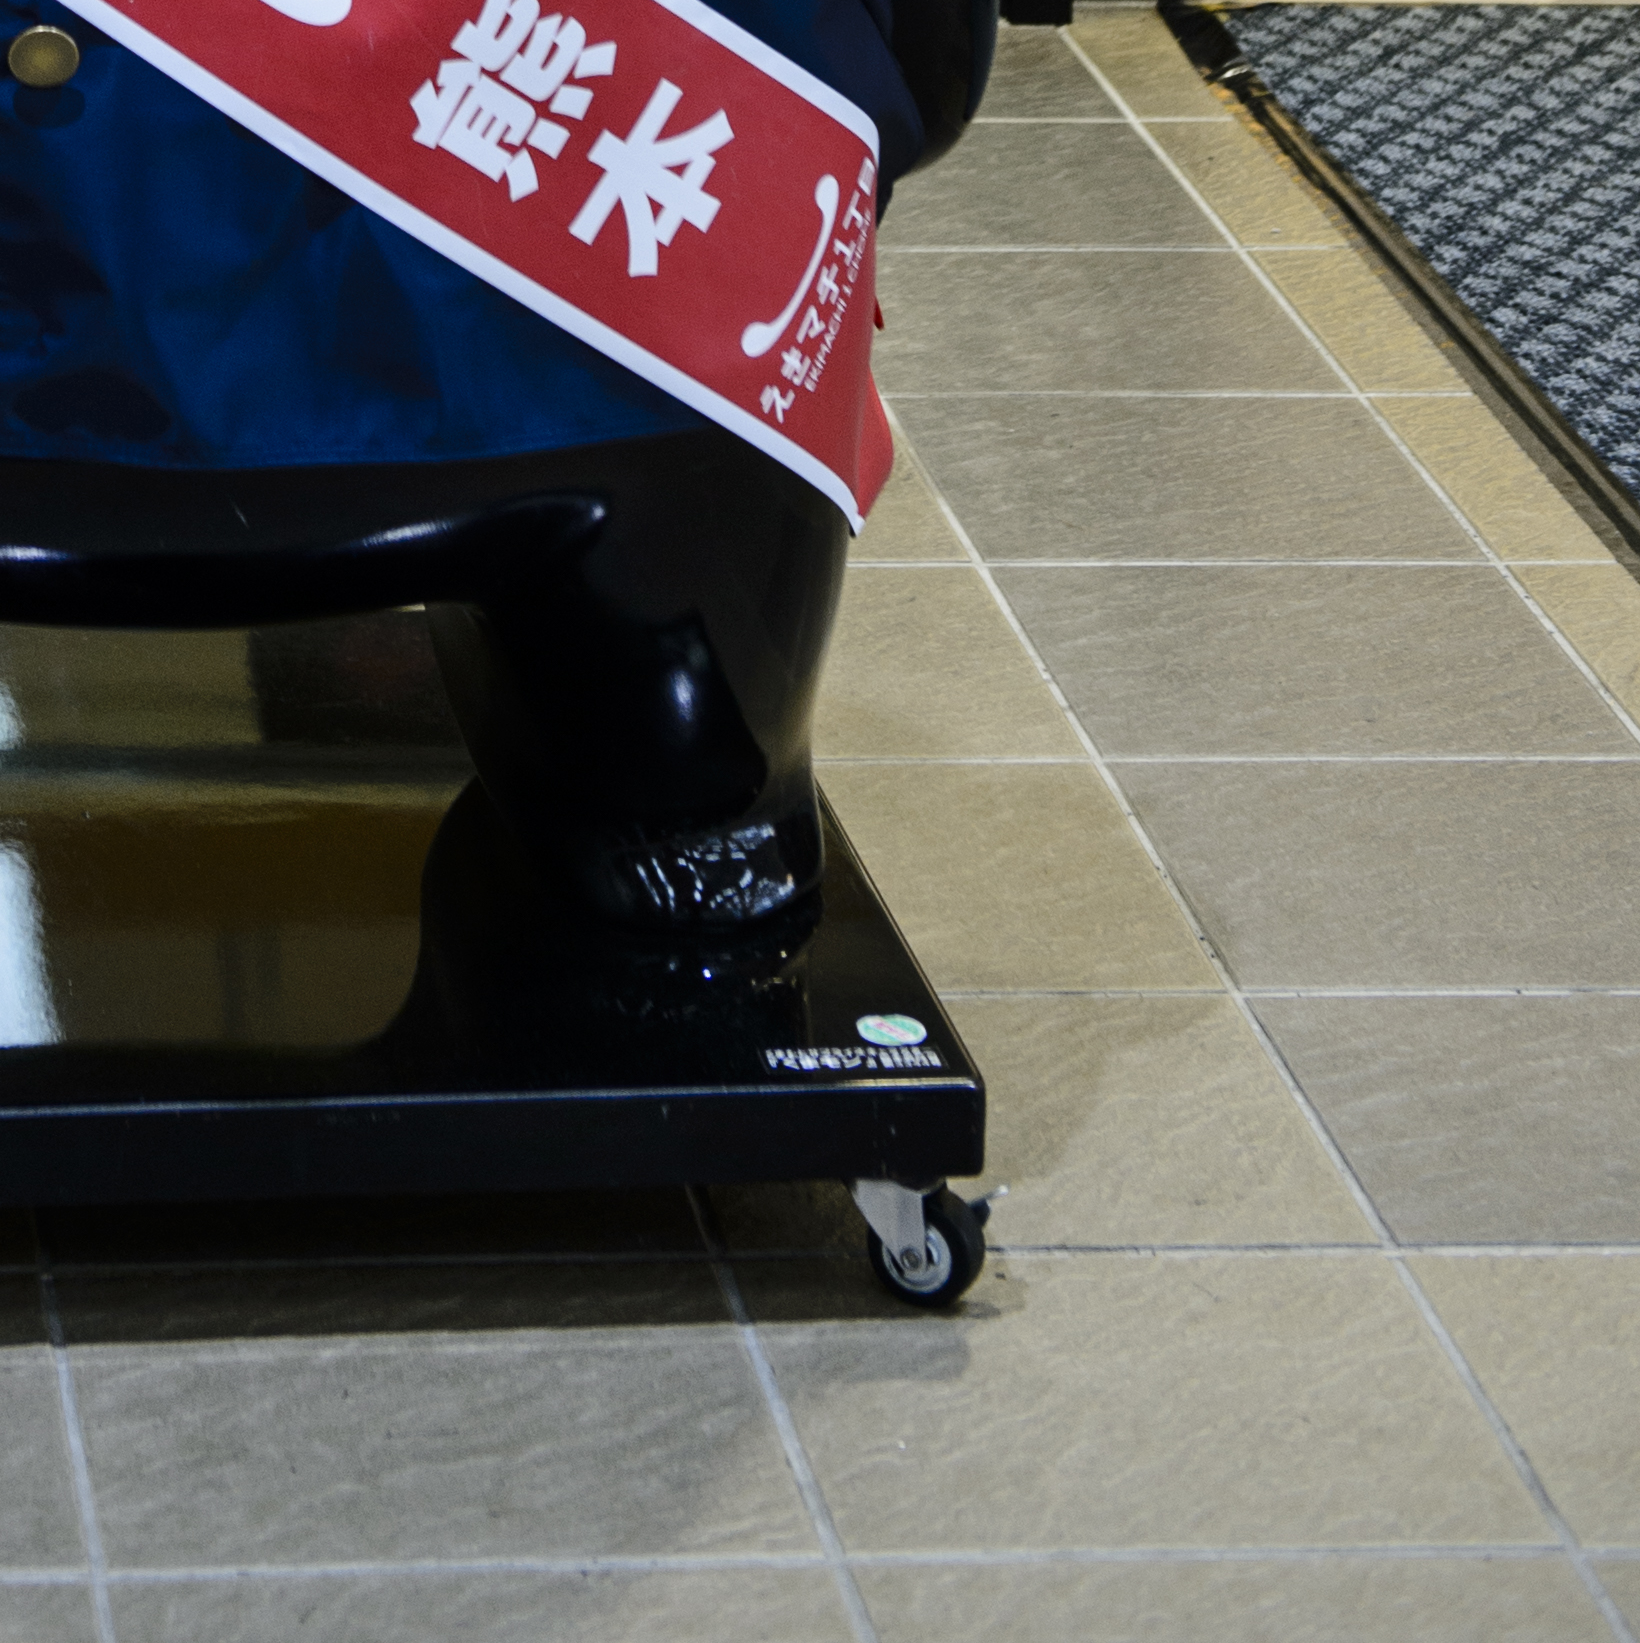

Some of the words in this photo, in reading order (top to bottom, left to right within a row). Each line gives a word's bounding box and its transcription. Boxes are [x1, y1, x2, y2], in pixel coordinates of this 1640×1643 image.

[759, 156, 876, 424] えきマチ1丁目
[804, 297, 847, 393] EKIMACHI
